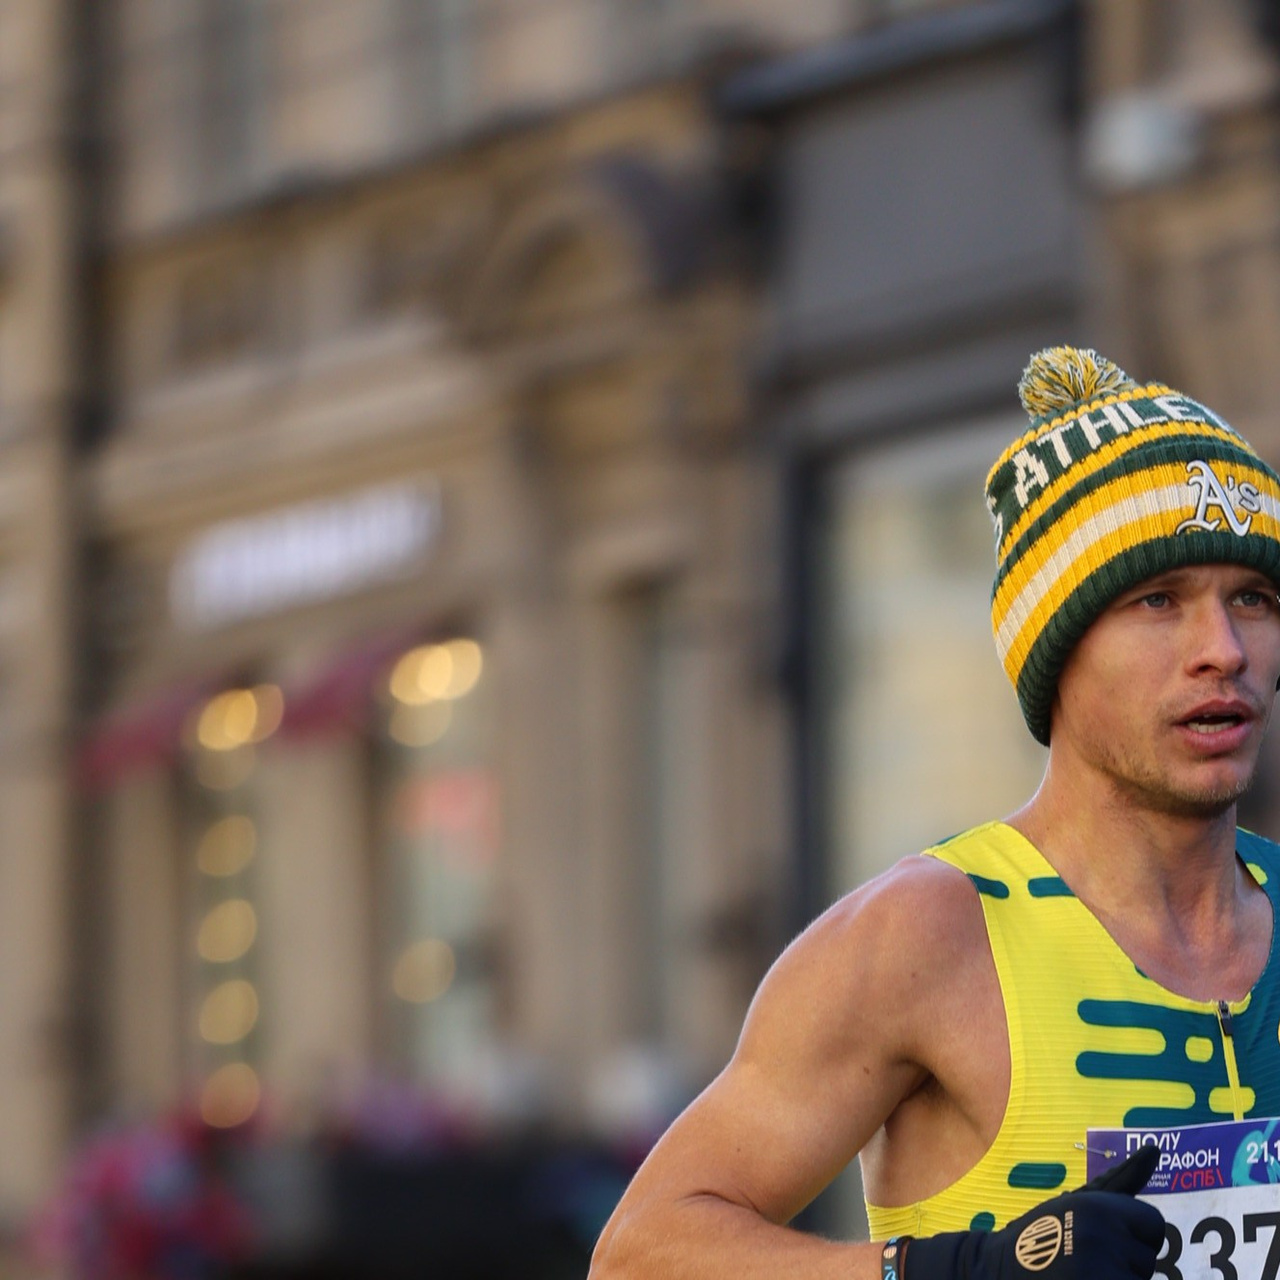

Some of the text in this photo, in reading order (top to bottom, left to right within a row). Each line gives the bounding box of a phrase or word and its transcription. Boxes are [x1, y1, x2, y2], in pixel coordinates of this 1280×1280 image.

[1011, 395, 1248, 509] ATHLE
[1177, 459, 1261, 537] A's
[1126, 1148, 1220, 1172] РАФОН
